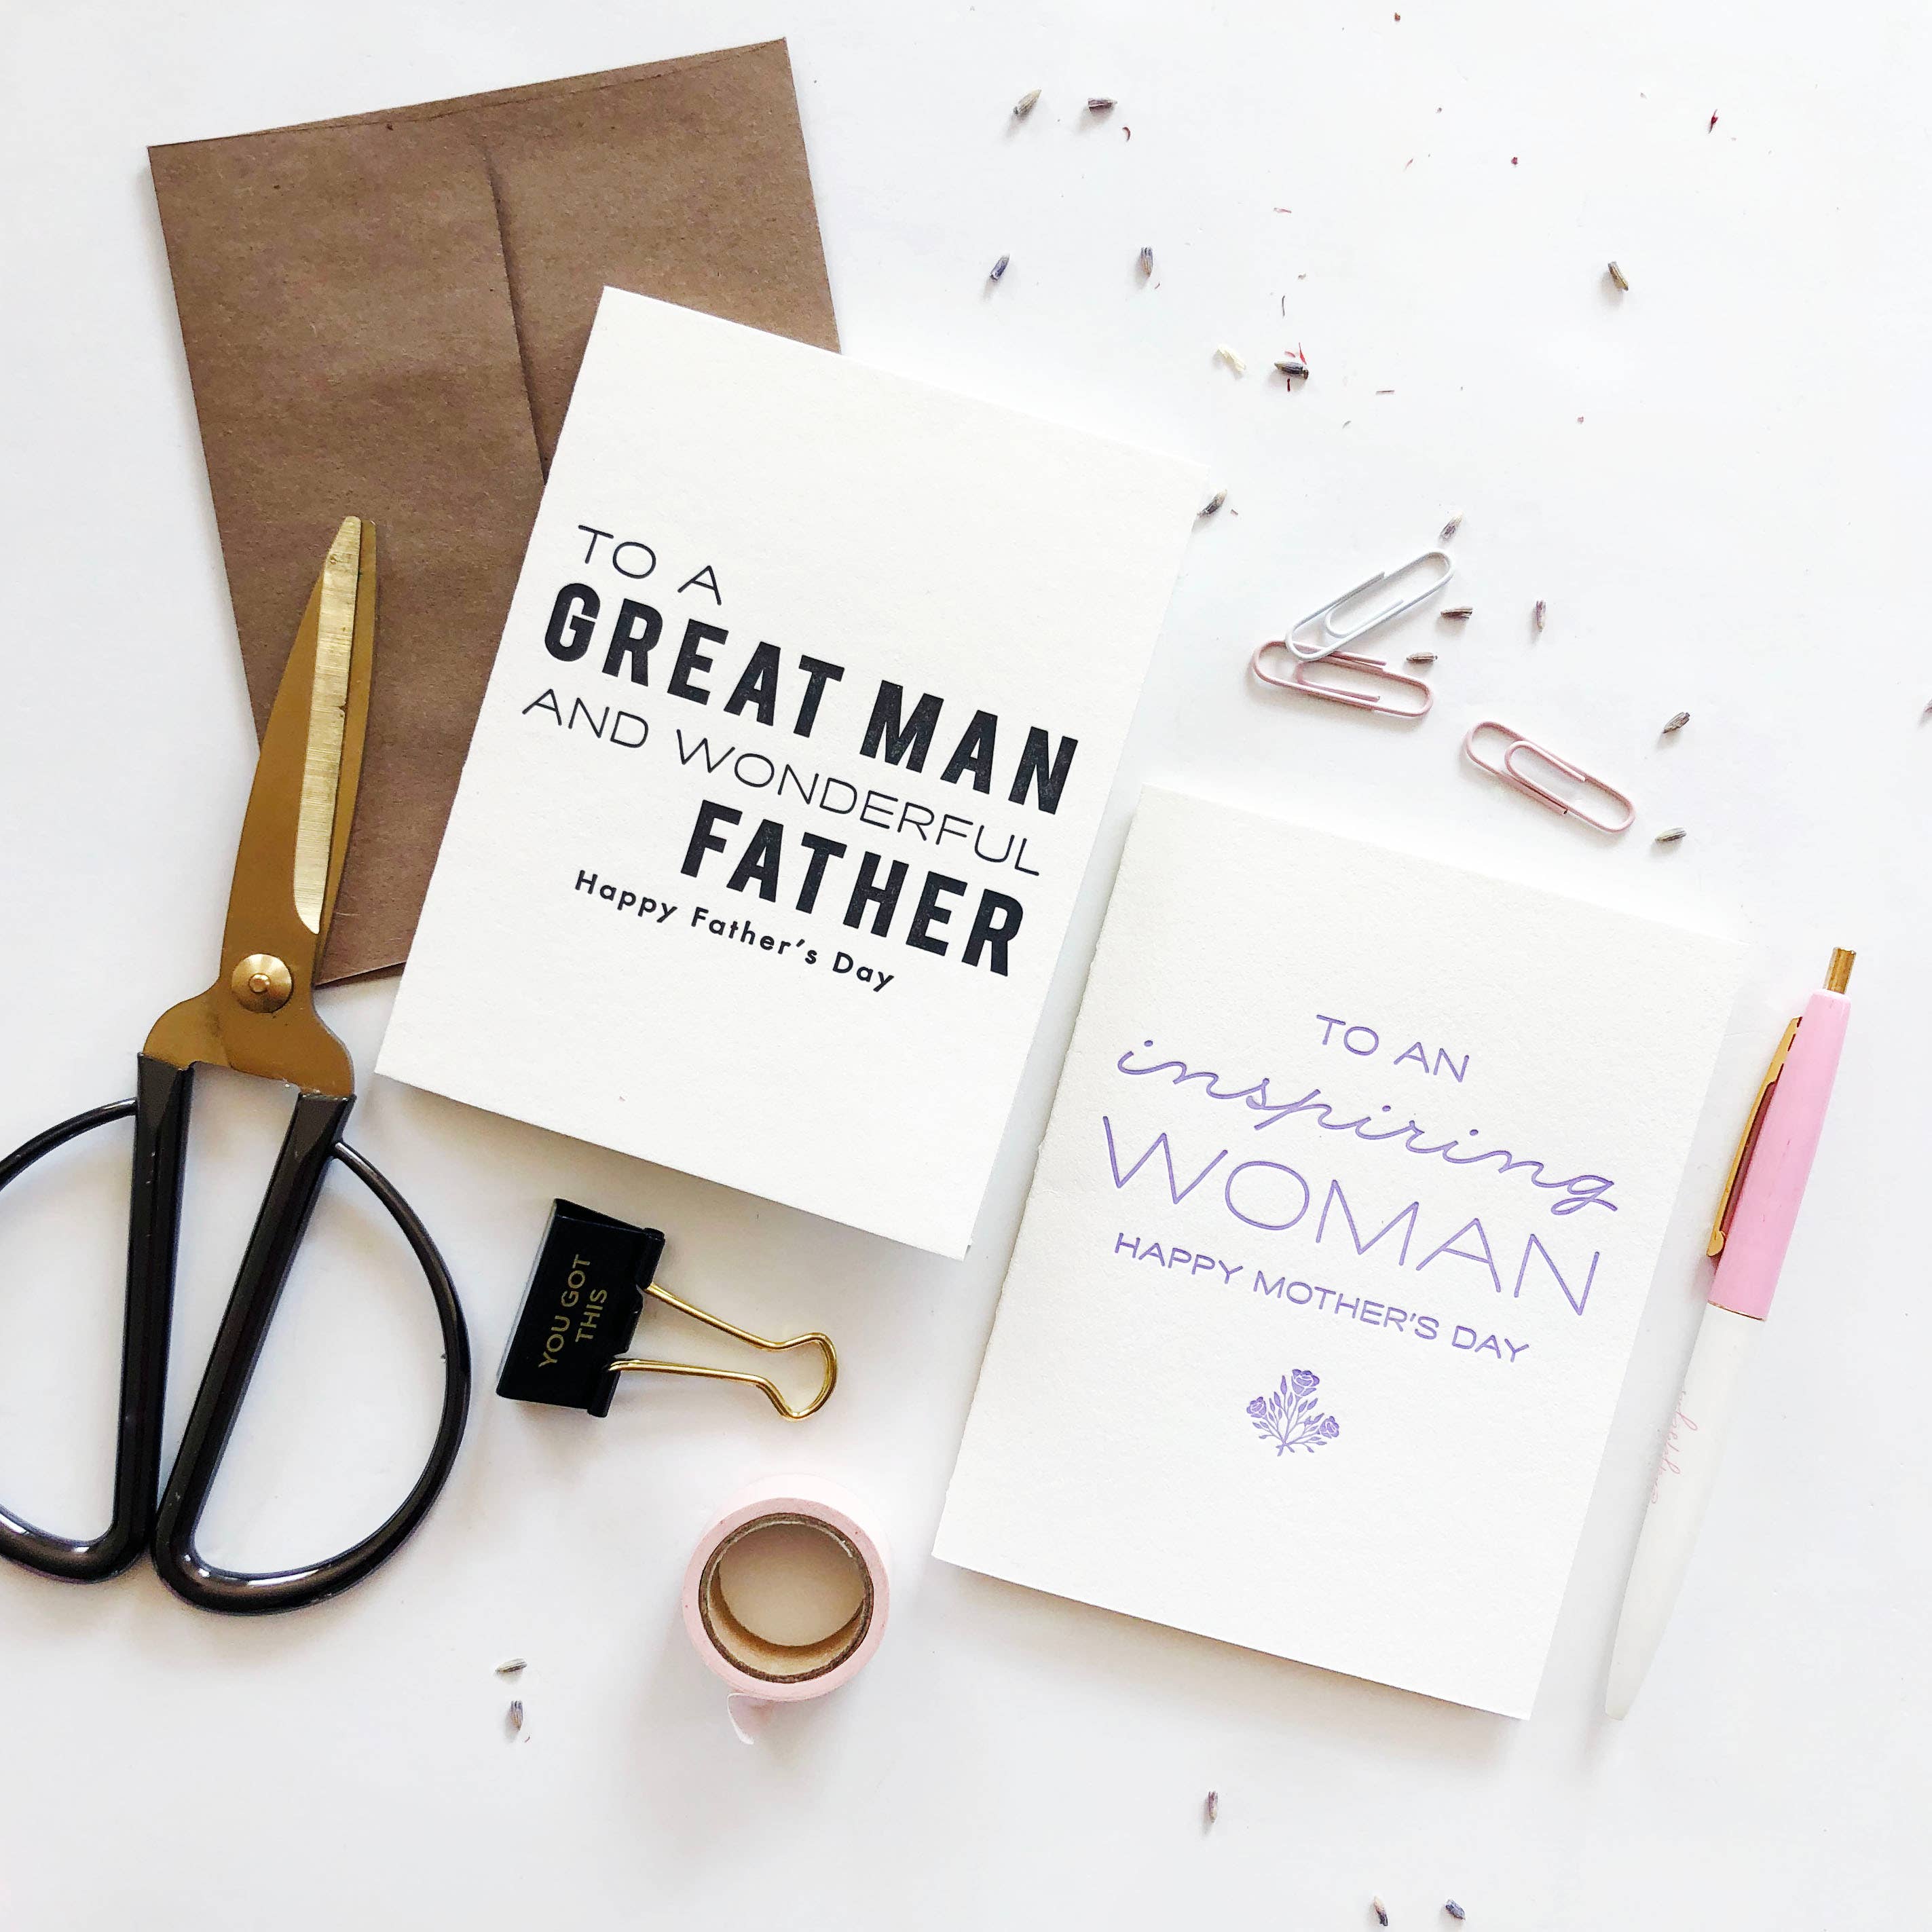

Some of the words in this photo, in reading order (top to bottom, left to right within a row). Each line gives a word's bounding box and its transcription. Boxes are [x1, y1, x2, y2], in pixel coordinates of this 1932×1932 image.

[578, 525, 656, 580] TO
[677, 565, 722, 606] A
[544, 582, 845, 738] GREAT
[859, 680, 1079, 815] MAN
[522, 688, 649, 749] AND
[676, 728, 1040, 876] WONDERFUL
[574, 870, 678, 923] Happy
[690, 907, 817, 965] Father's
[832, 952, 895, 992] Day
[680, 800, 1024, 977] FATHER
[1316, 1014, 1379, 1056] TO
[1394, 1042, 1470, 1083] AN
[1117, 1040, 1618, 1215] inspiring
[1103, 1116, 1599, 1317] WOMAN
[539, 1315, 570, 1367] YOU
[561, 1254, 591, 1307] GOT
[576, 1289, 608, 1342] THIS
[1115, 1232, 1244, 1284] HAPPY
[1253, 1270, 1440, 1340] MOTHER'S
[1451, 1326, 1529, 1362] DAY
